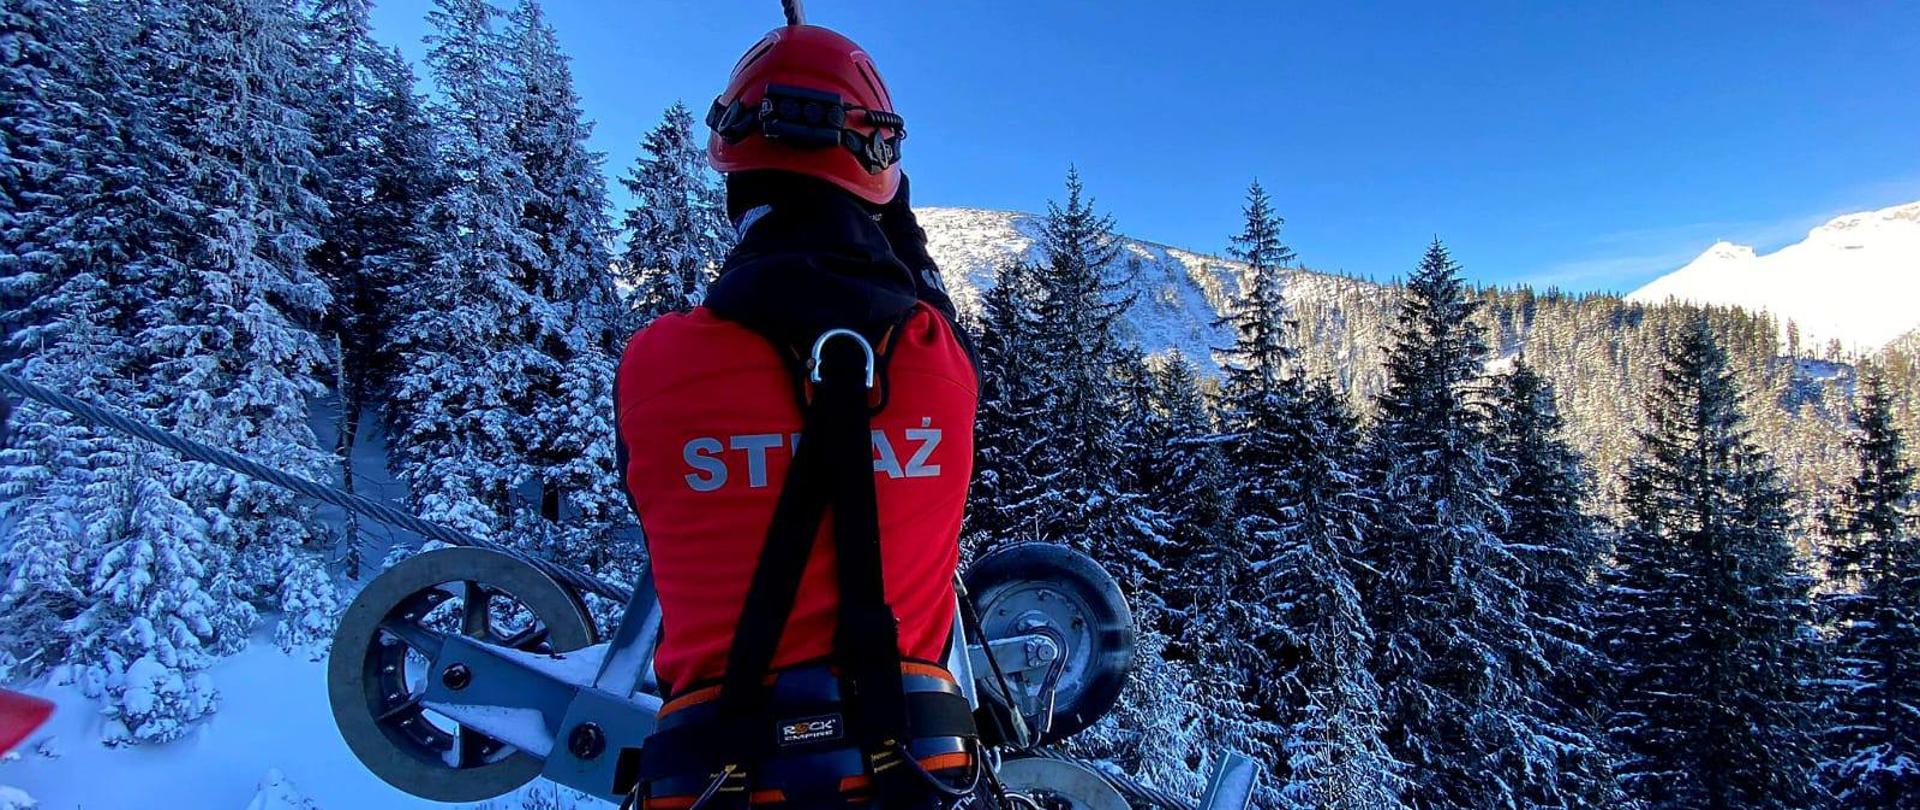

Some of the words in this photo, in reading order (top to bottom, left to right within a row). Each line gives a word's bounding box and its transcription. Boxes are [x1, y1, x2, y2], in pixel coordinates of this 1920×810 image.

[683, 416, 942, 492] STAŻ
[783, 719, 833, 735] ROCK
[784, 729, 834, 741] EMPIRE
